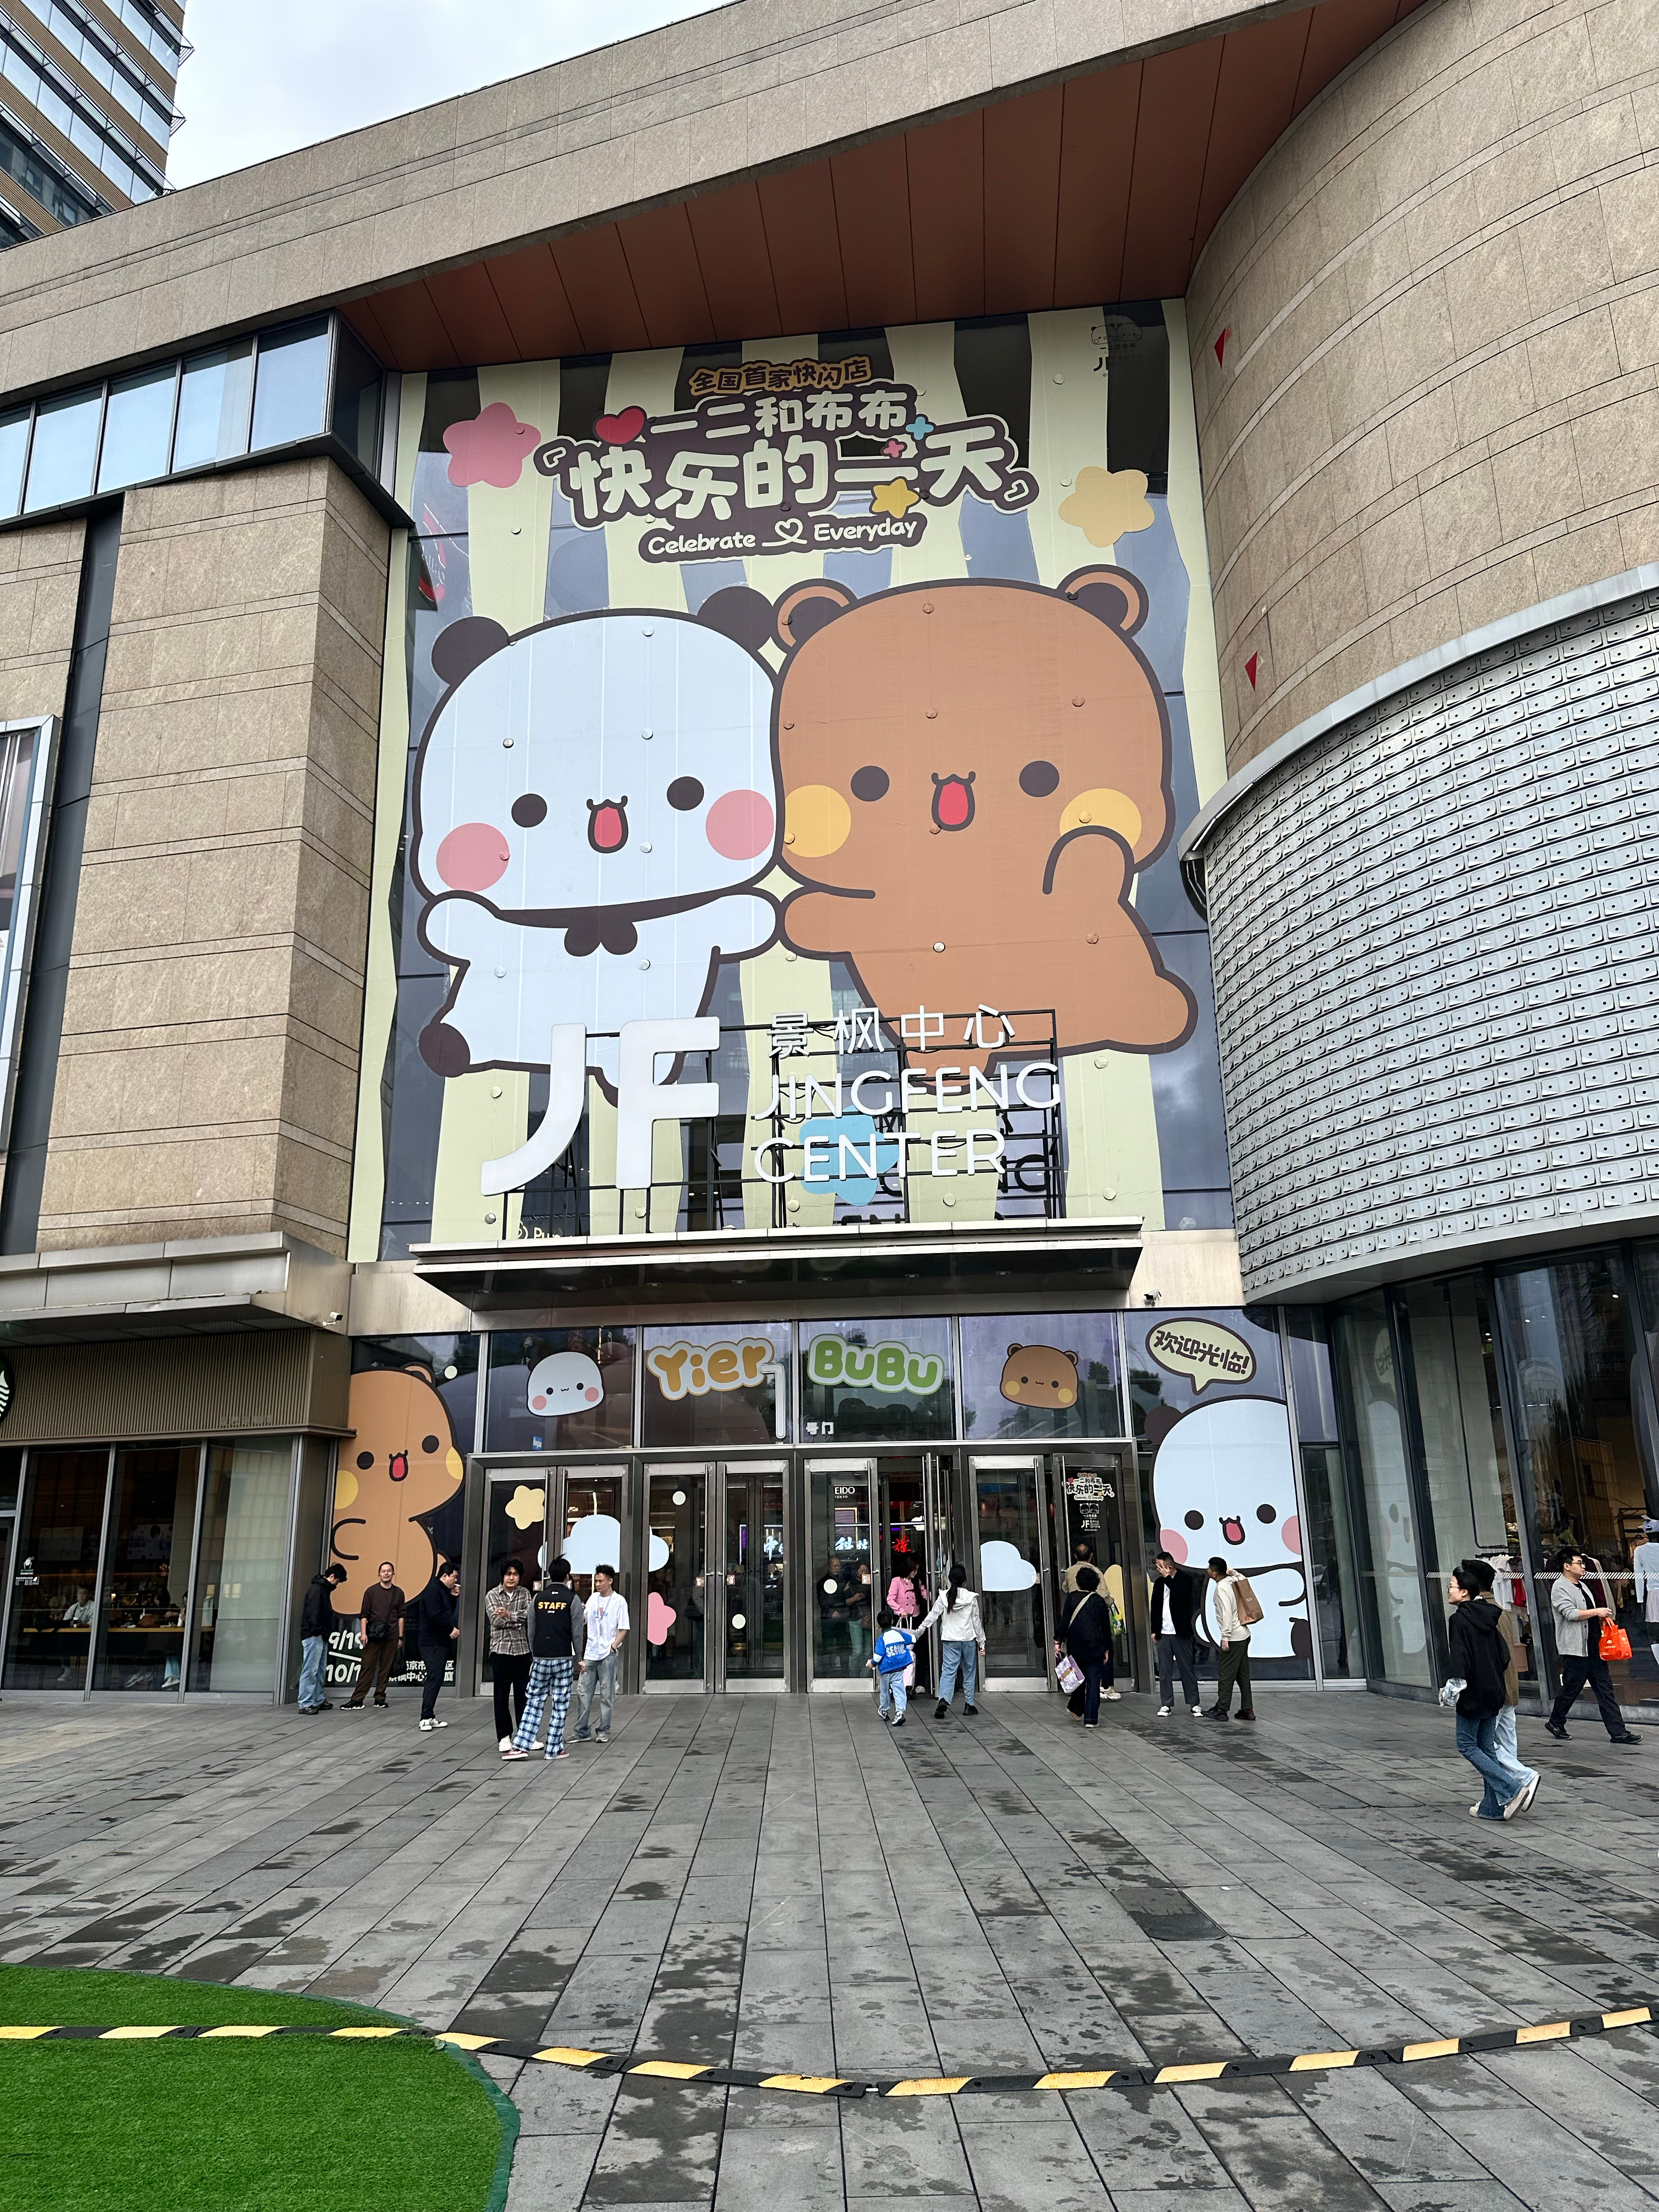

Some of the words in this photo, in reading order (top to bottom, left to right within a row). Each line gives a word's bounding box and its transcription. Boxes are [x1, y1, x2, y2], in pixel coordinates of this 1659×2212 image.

[692, 359, 868, 392] 全国首家快闪店
[650, 389, 908, 437] 一二和布布
[648, 531, 755, 555] Celebrate
[814, 518, 917, 541] Everyday
[766, 1003, 1015, 1058] 景枫中心
[480, 1015, 720, 1197] JF
[754, 1062, 1061, 1120] JINGFENG
[754, 1128, 1006, 1183] CENTER
[652, 1344, 768, 1393] Yier
[813, 1339, 939, 1389] BuBu
[1153, 1330, 1250, 1375] 欢迎光临!
[538, 1601, 567, 1610] STAFF
